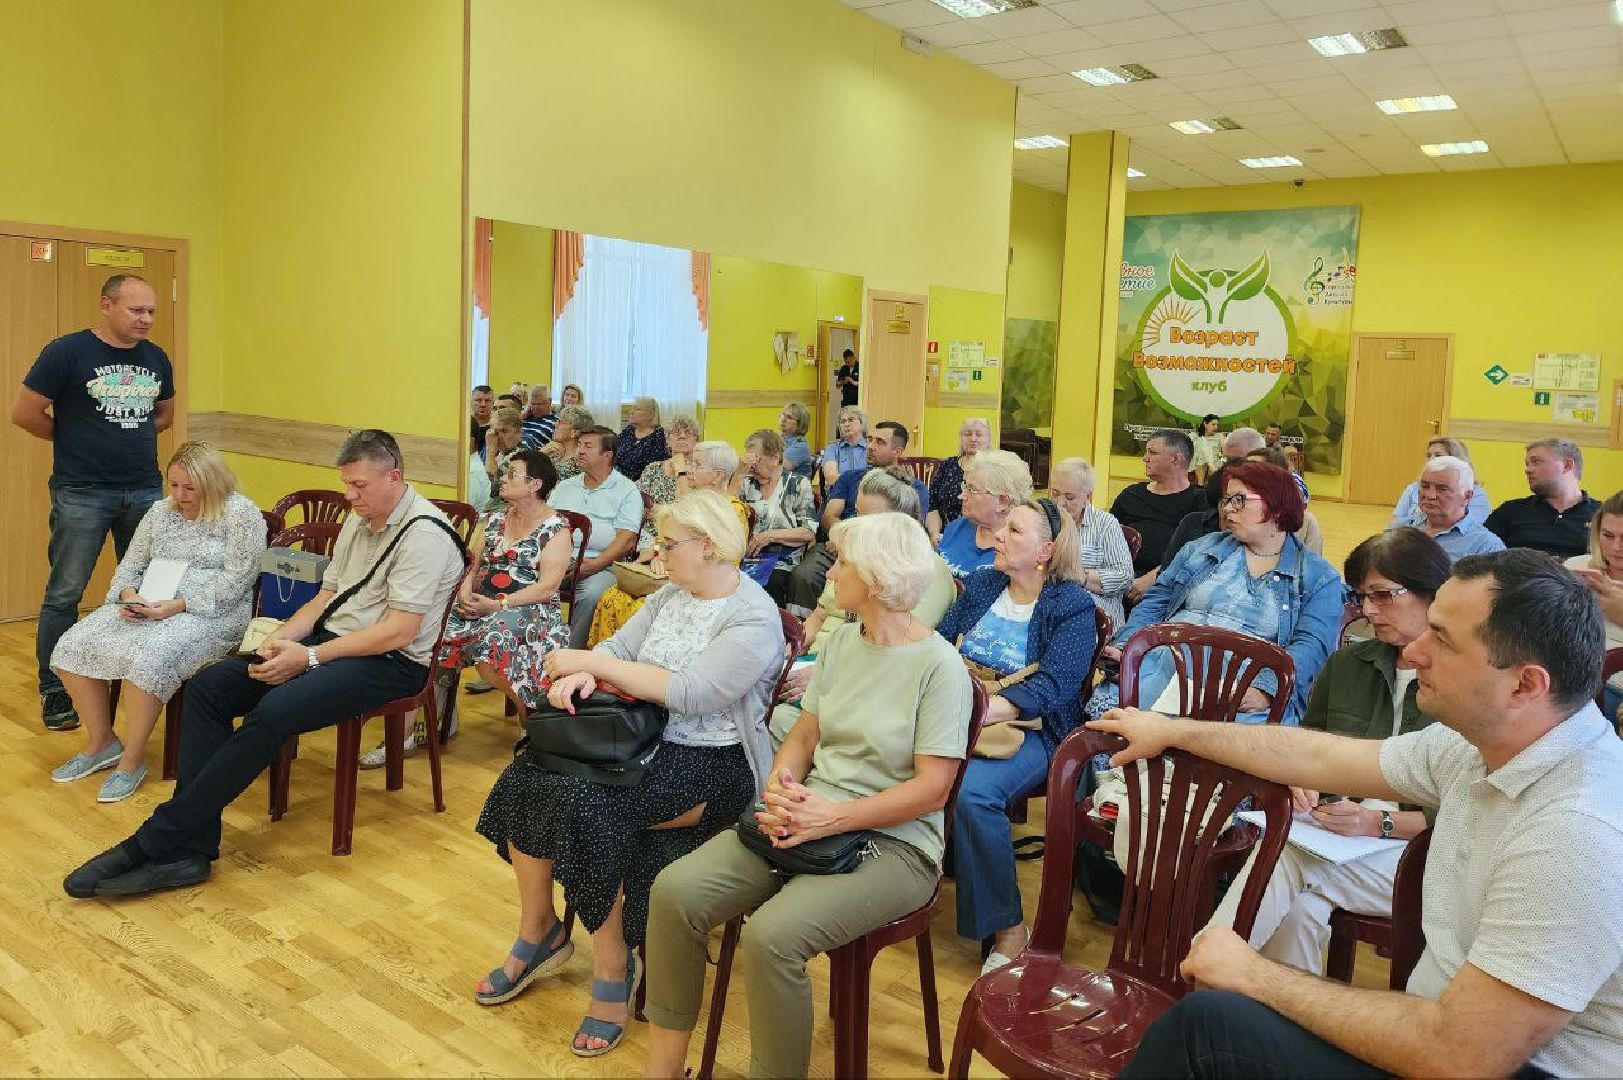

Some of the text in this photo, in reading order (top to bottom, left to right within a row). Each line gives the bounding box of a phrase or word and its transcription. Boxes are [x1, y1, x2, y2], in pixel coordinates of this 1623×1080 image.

[1169, 326, 1260, 349] Возраст
[1132, 350, 1297, 375] Возможностей
[1191, 380, 1228, 394] клуб
